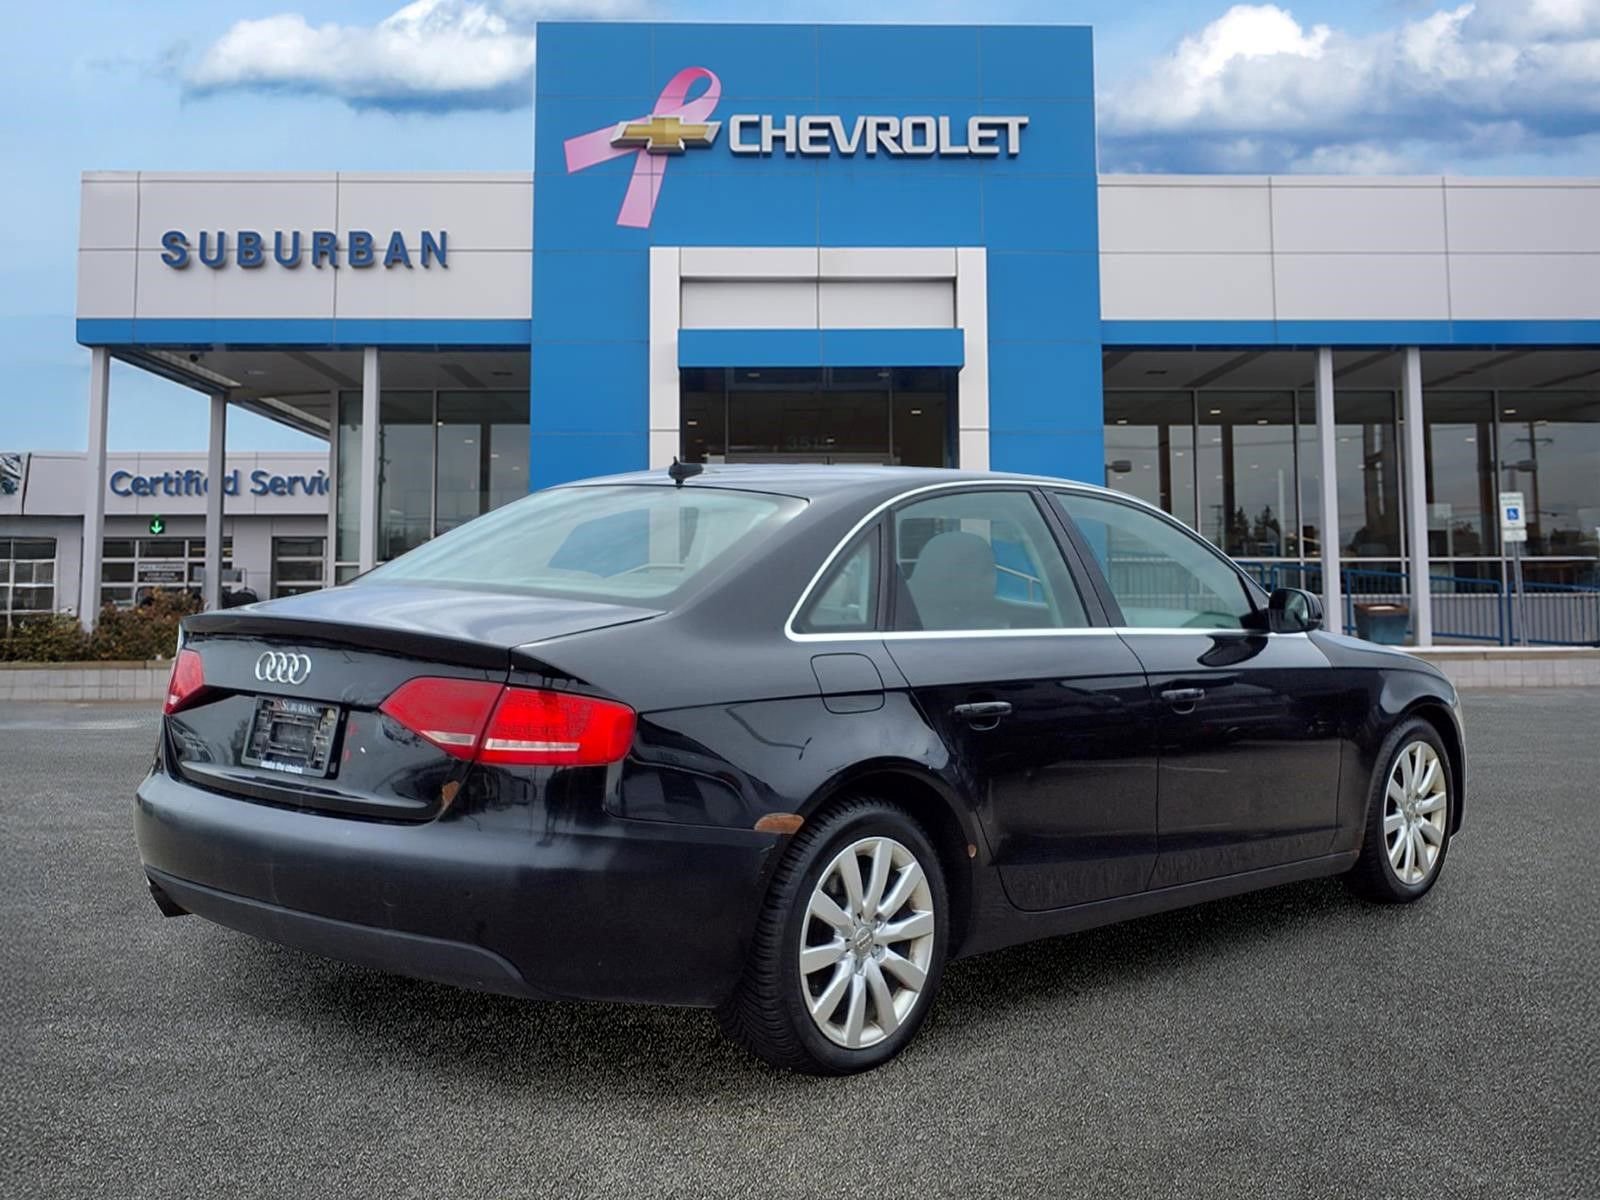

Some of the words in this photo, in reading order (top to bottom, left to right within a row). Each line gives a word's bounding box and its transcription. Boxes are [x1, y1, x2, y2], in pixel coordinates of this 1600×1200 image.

[729, 114, 1029, 156] CHEVROLET
[160, 230, 449, 269] SUBURBAN
[110, 469, 240, 497] Certifid
